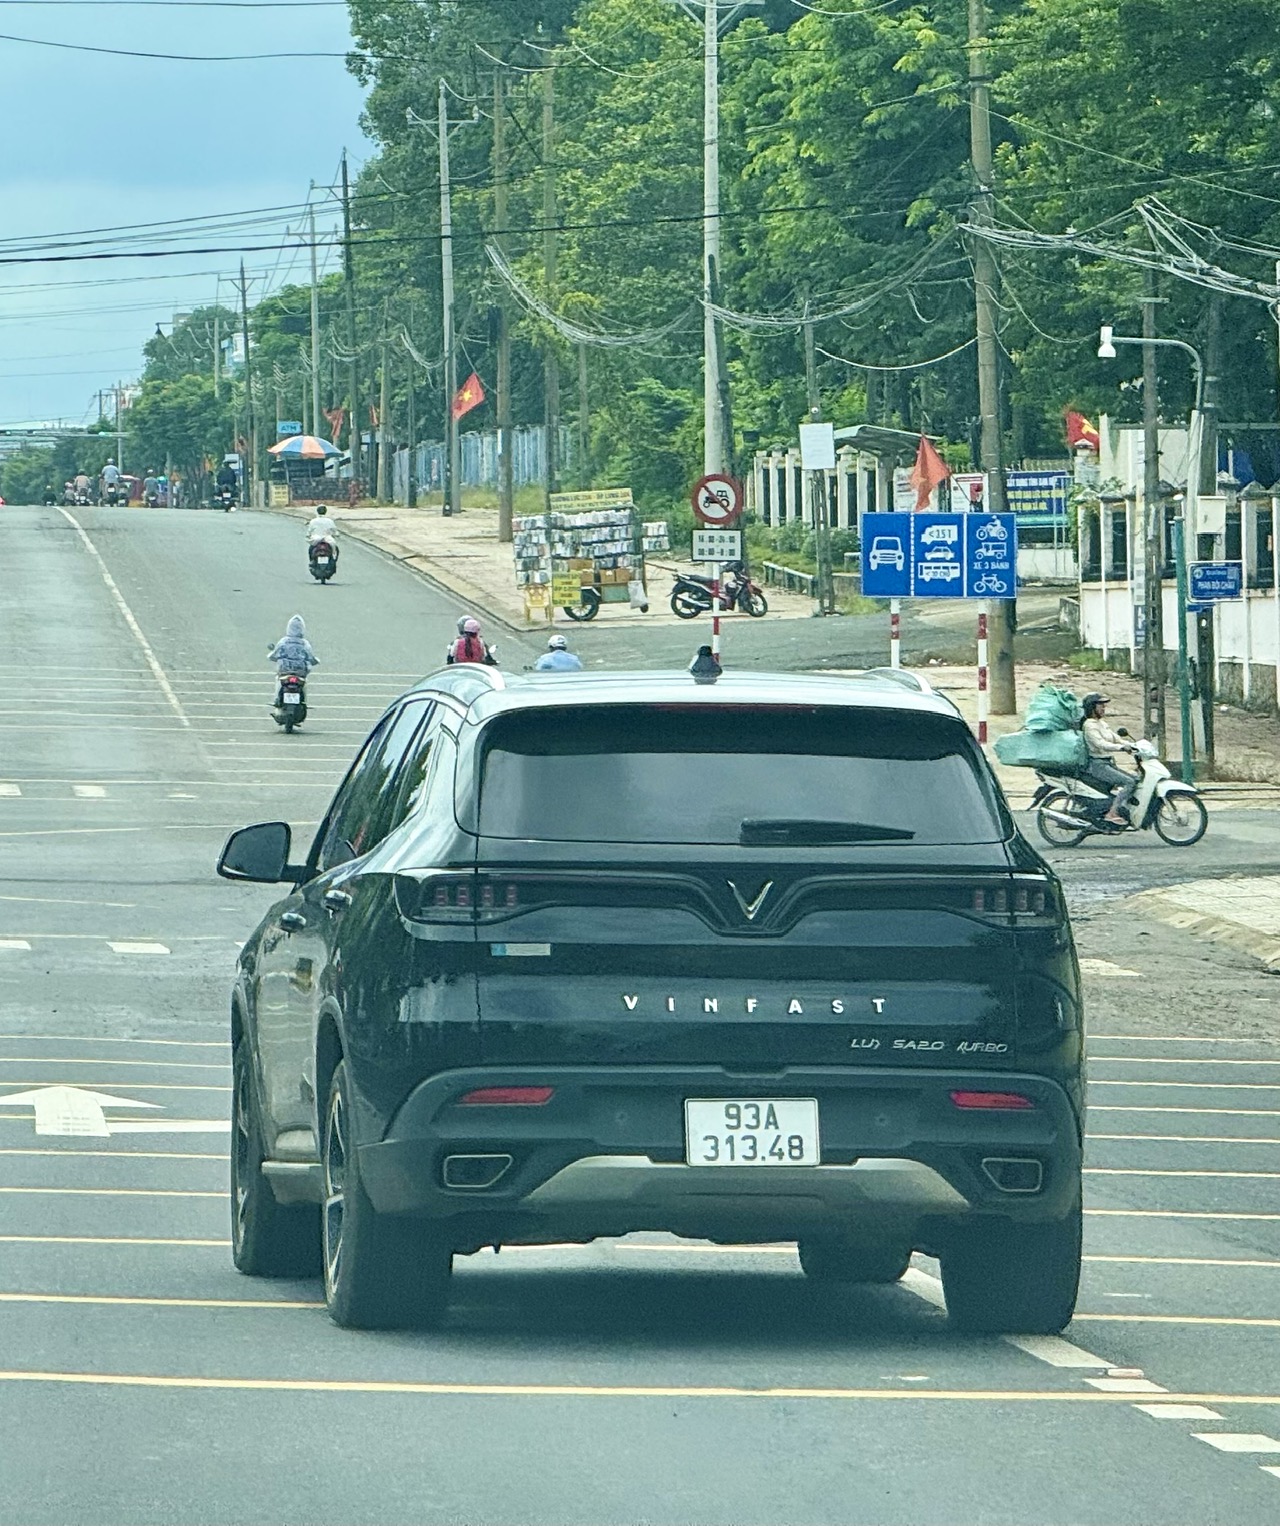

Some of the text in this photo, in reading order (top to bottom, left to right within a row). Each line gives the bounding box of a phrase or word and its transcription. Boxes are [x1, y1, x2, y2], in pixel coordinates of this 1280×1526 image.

[623, 995, 887, 1015] VINFAST
[723, 1103, 779, 1131] 93A
[702, 1133, 805, 1163] 313.48
